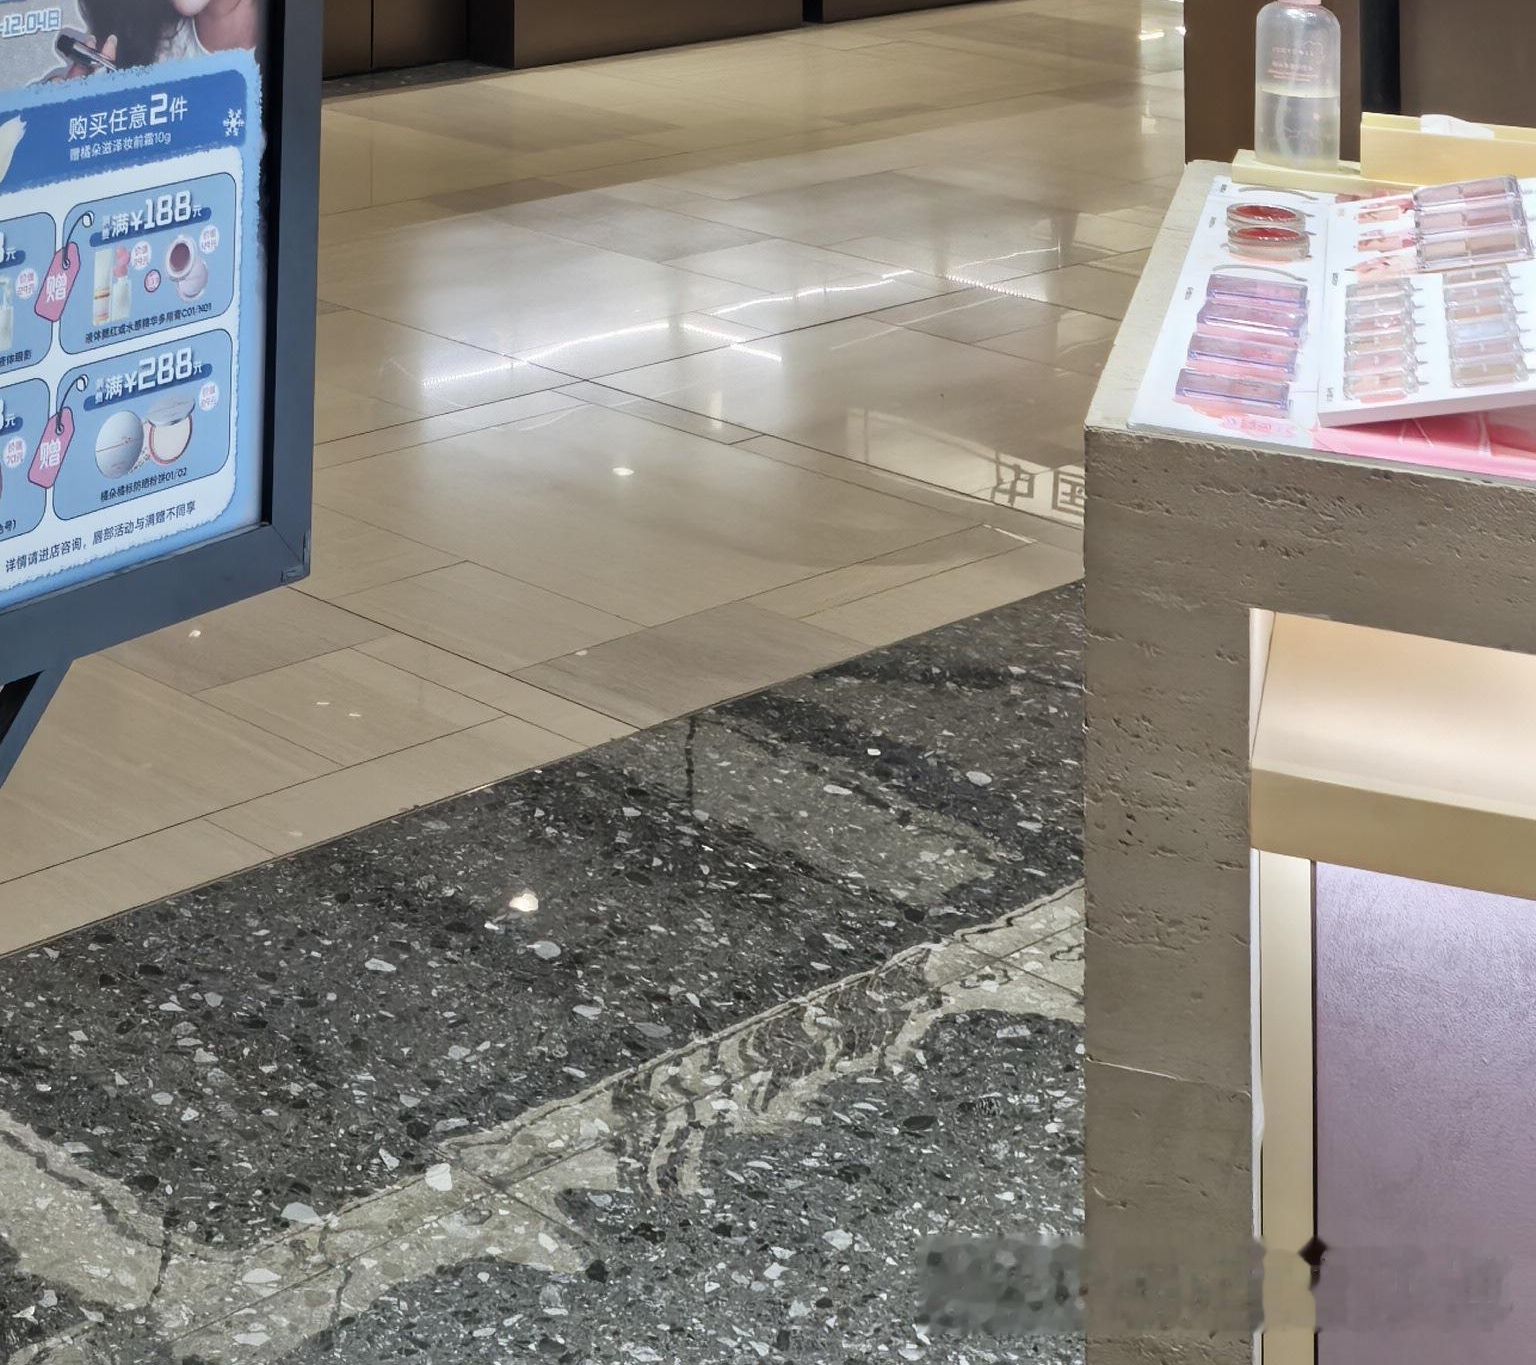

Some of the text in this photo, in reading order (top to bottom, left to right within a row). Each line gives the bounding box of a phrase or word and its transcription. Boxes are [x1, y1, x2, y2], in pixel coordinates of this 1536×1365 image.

[68, 92, 189, 143] 购买任意2件
[46, 273, 68, 303] 赠
[39, 438, 61, 470] 赠
